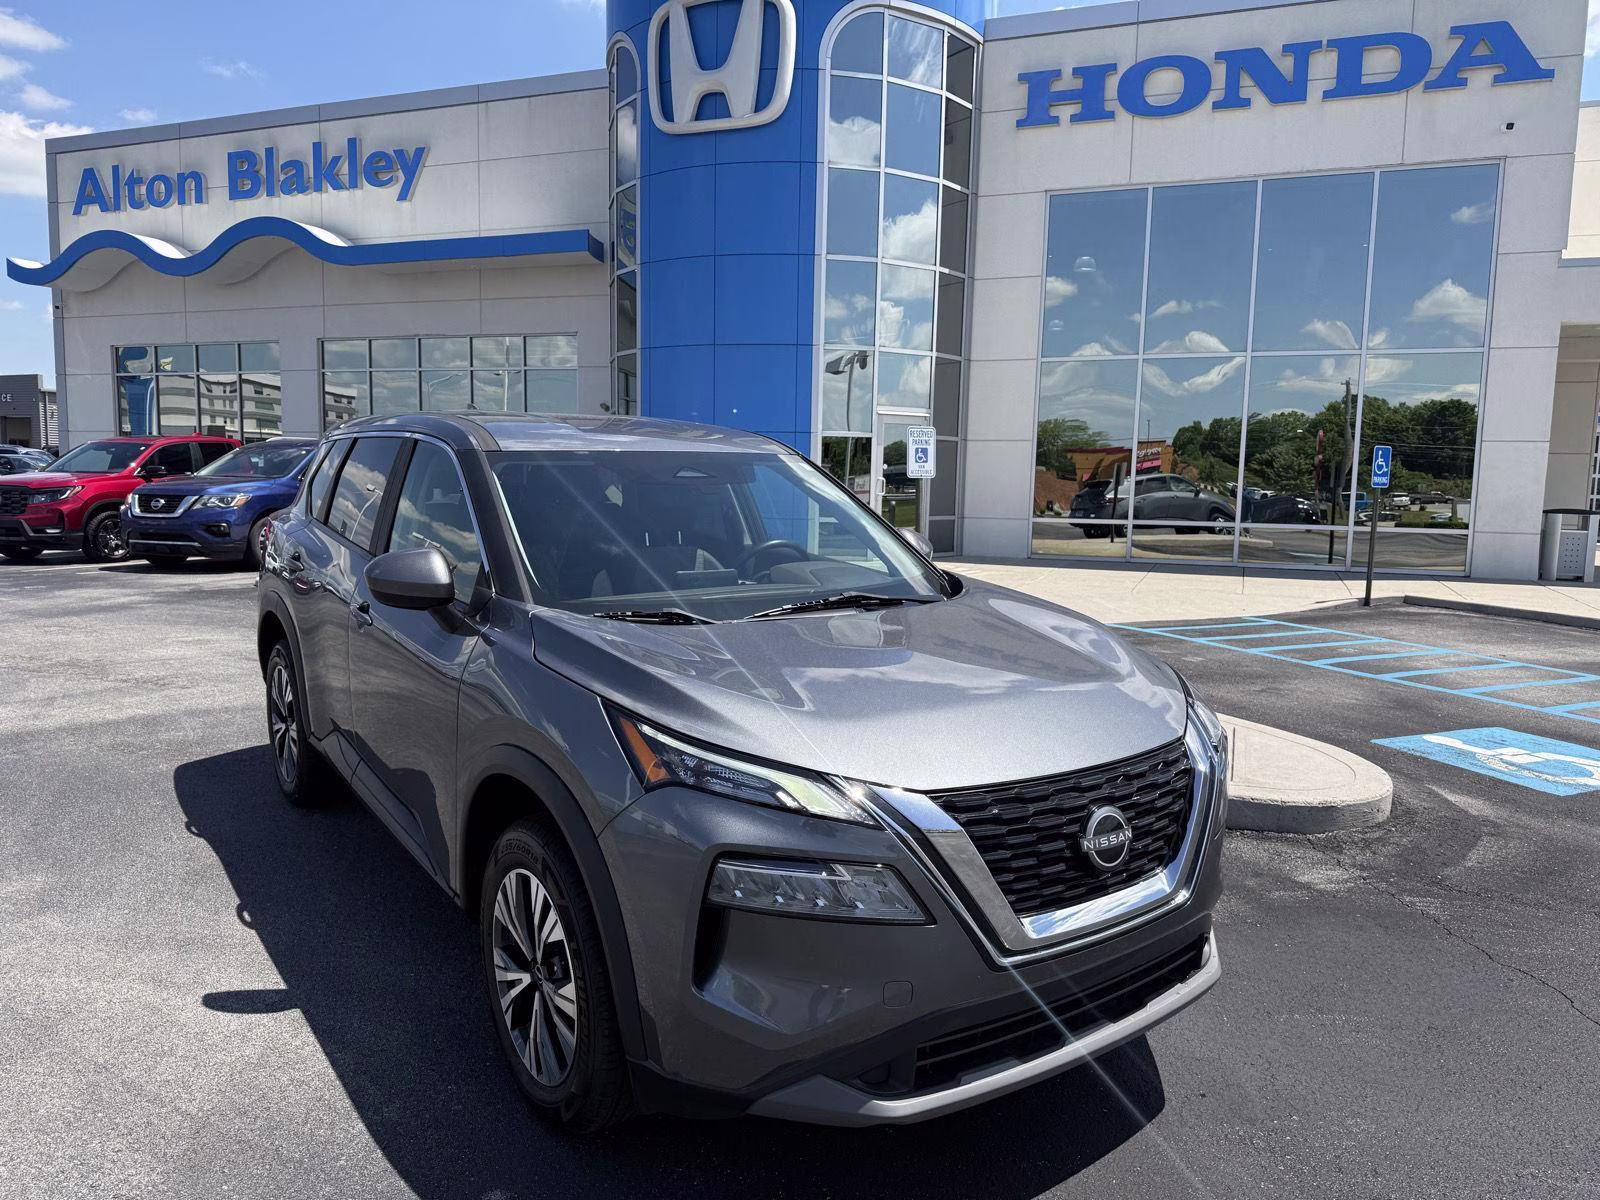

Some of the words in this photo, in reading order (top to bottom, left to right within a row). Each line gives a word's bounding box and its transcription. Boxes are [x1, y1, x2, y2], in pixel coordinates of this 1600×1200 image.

[1016, 20, 1555, 128] HONDA
[72, 164, 204, 216] Alton
[227, 137, 425, 201] Blakley
[910, 430, 933, 438] RESERVED
[1083, 828, 1132, 850] NISSAN
